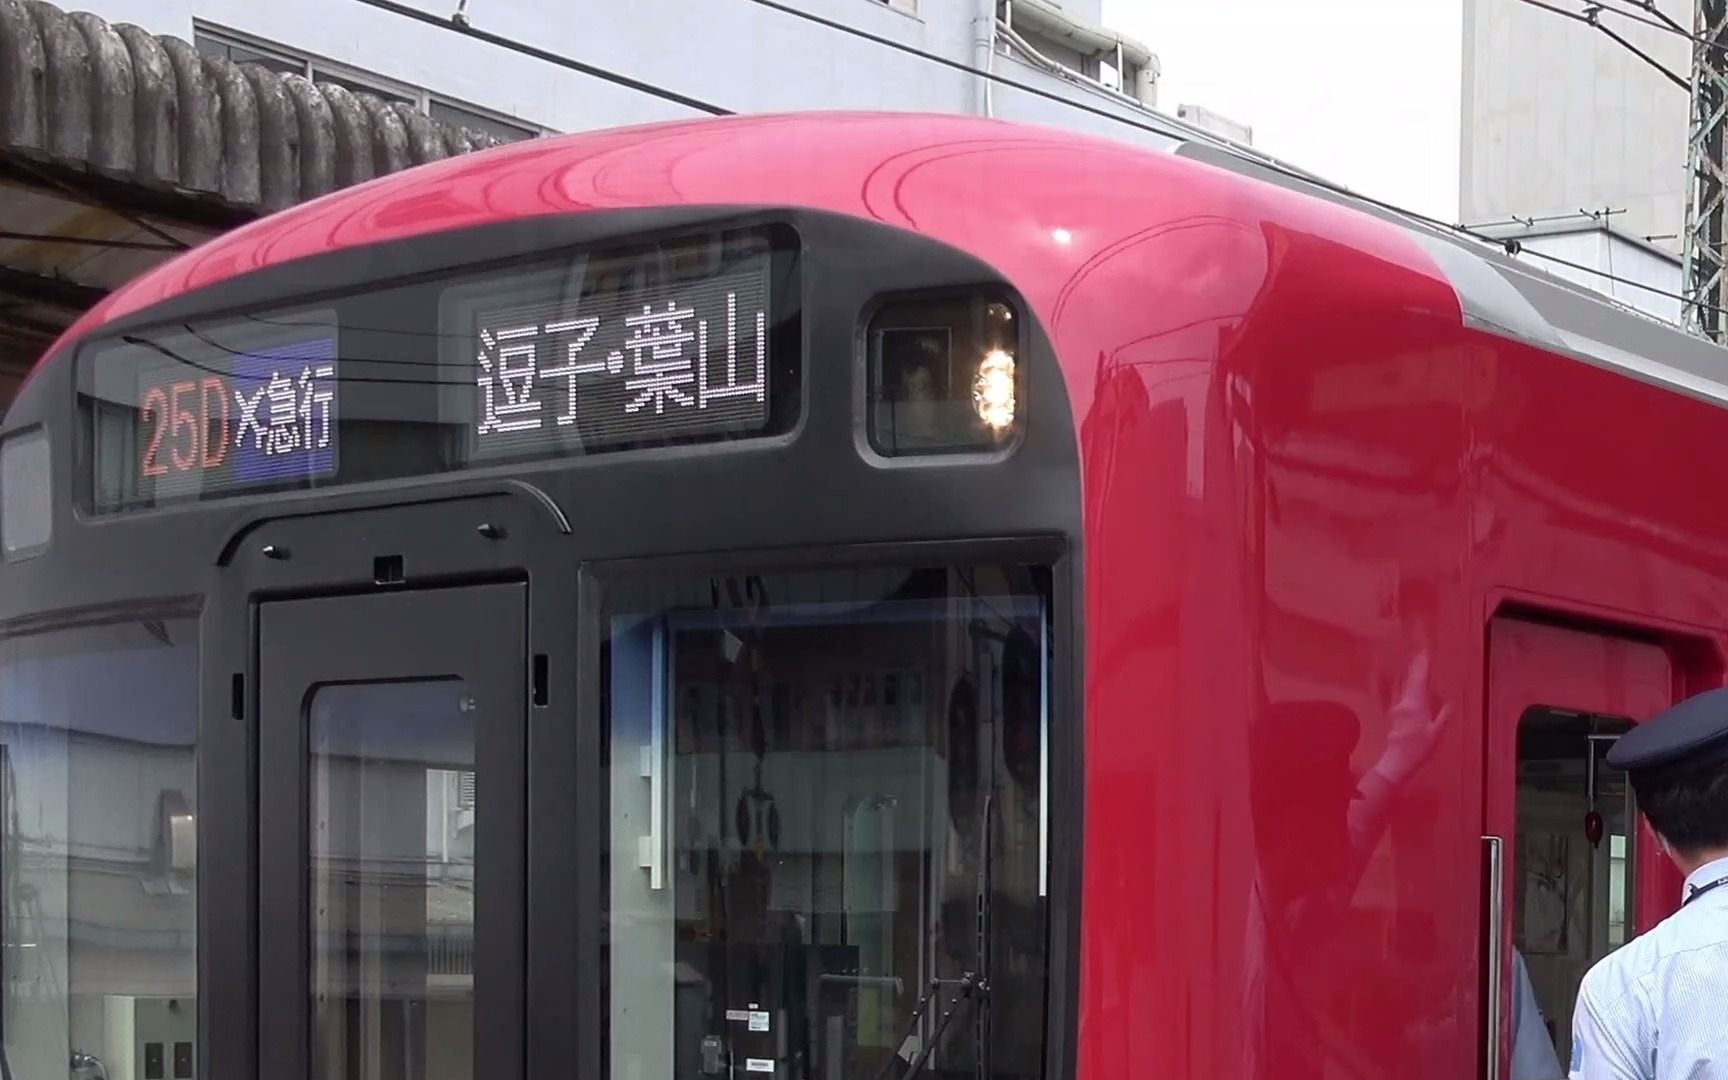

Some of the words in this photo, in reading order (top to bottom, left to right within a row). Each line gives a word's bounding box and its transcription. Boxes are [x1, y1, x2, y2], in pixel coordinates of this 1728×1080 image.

[478, 292, 765, 434] 逗子・葉山
[142, 375, 230, 477] 25D
